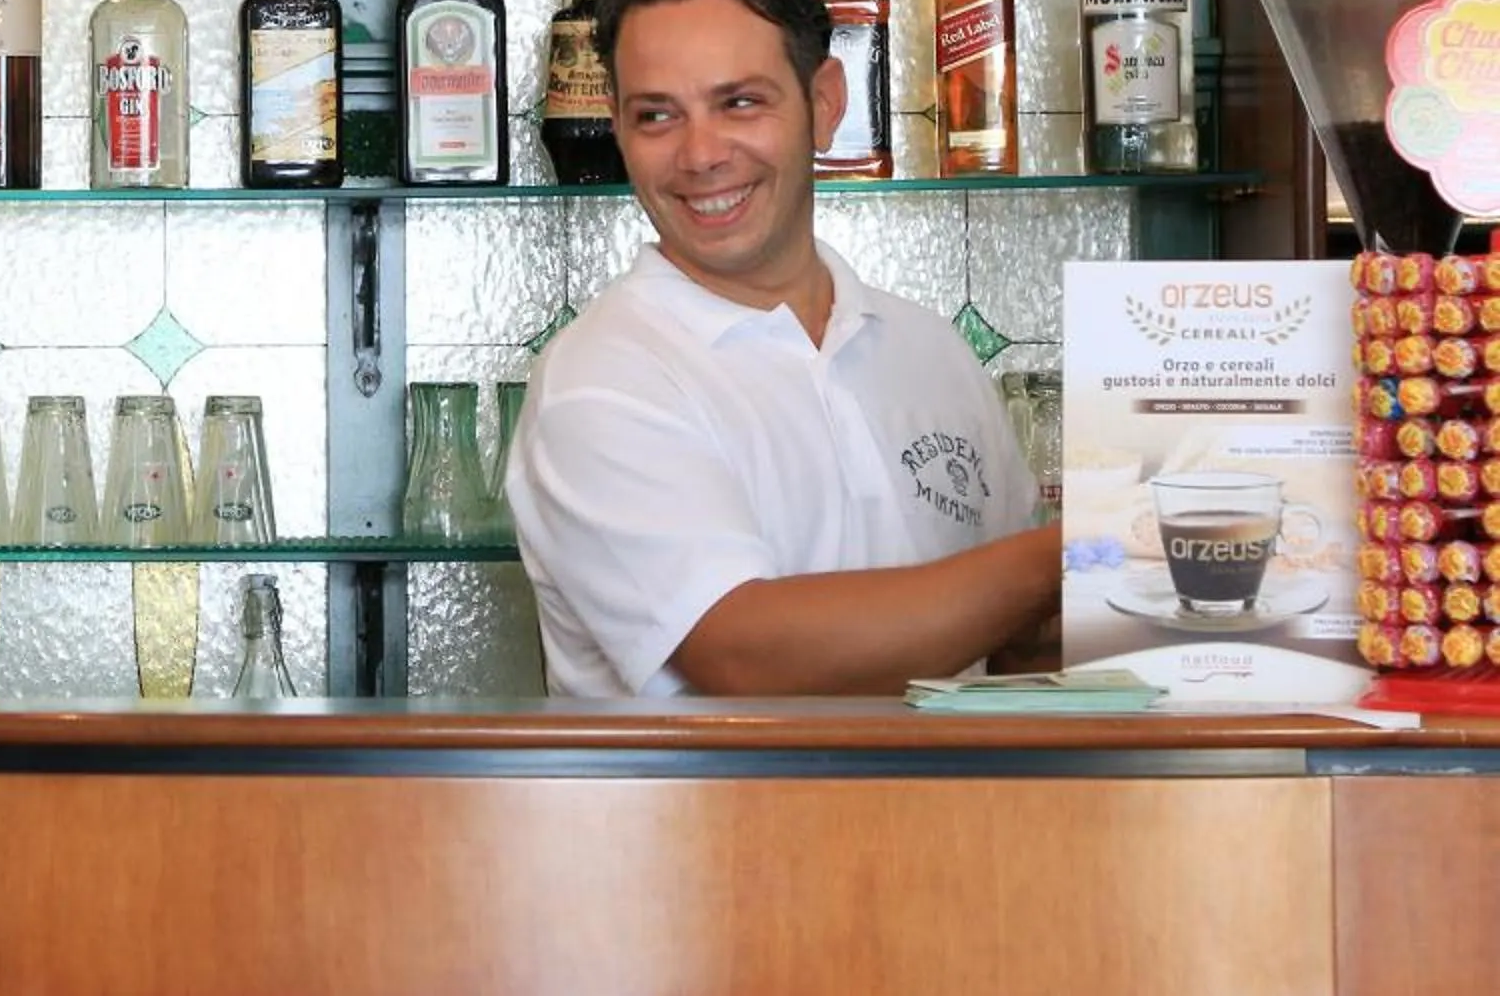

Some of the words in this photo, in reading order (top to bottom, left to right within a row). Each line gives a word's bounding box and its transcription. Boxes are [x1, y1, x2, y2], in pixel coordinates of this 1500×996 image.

[941, 27, 966, 47] Red
[966, 13, 999, 37] Label
[1160, 283, 1273, 310] orzeus
[1180, 329, 1256, 341] CEREALI
[1162, 358, 1199, 373] Orzo
[1205, 361, 1215, 372] e
[1219, 358, 1275, 373] cereali
[1102, 373, 1161, 391] gustosi
[1165, 376, 1175, 388] e
[1180, 373, 1290, 388] naturalmente
[1296, 373, 1336, 388] dolci
[1170, 536, 1263, 562] orzeus
